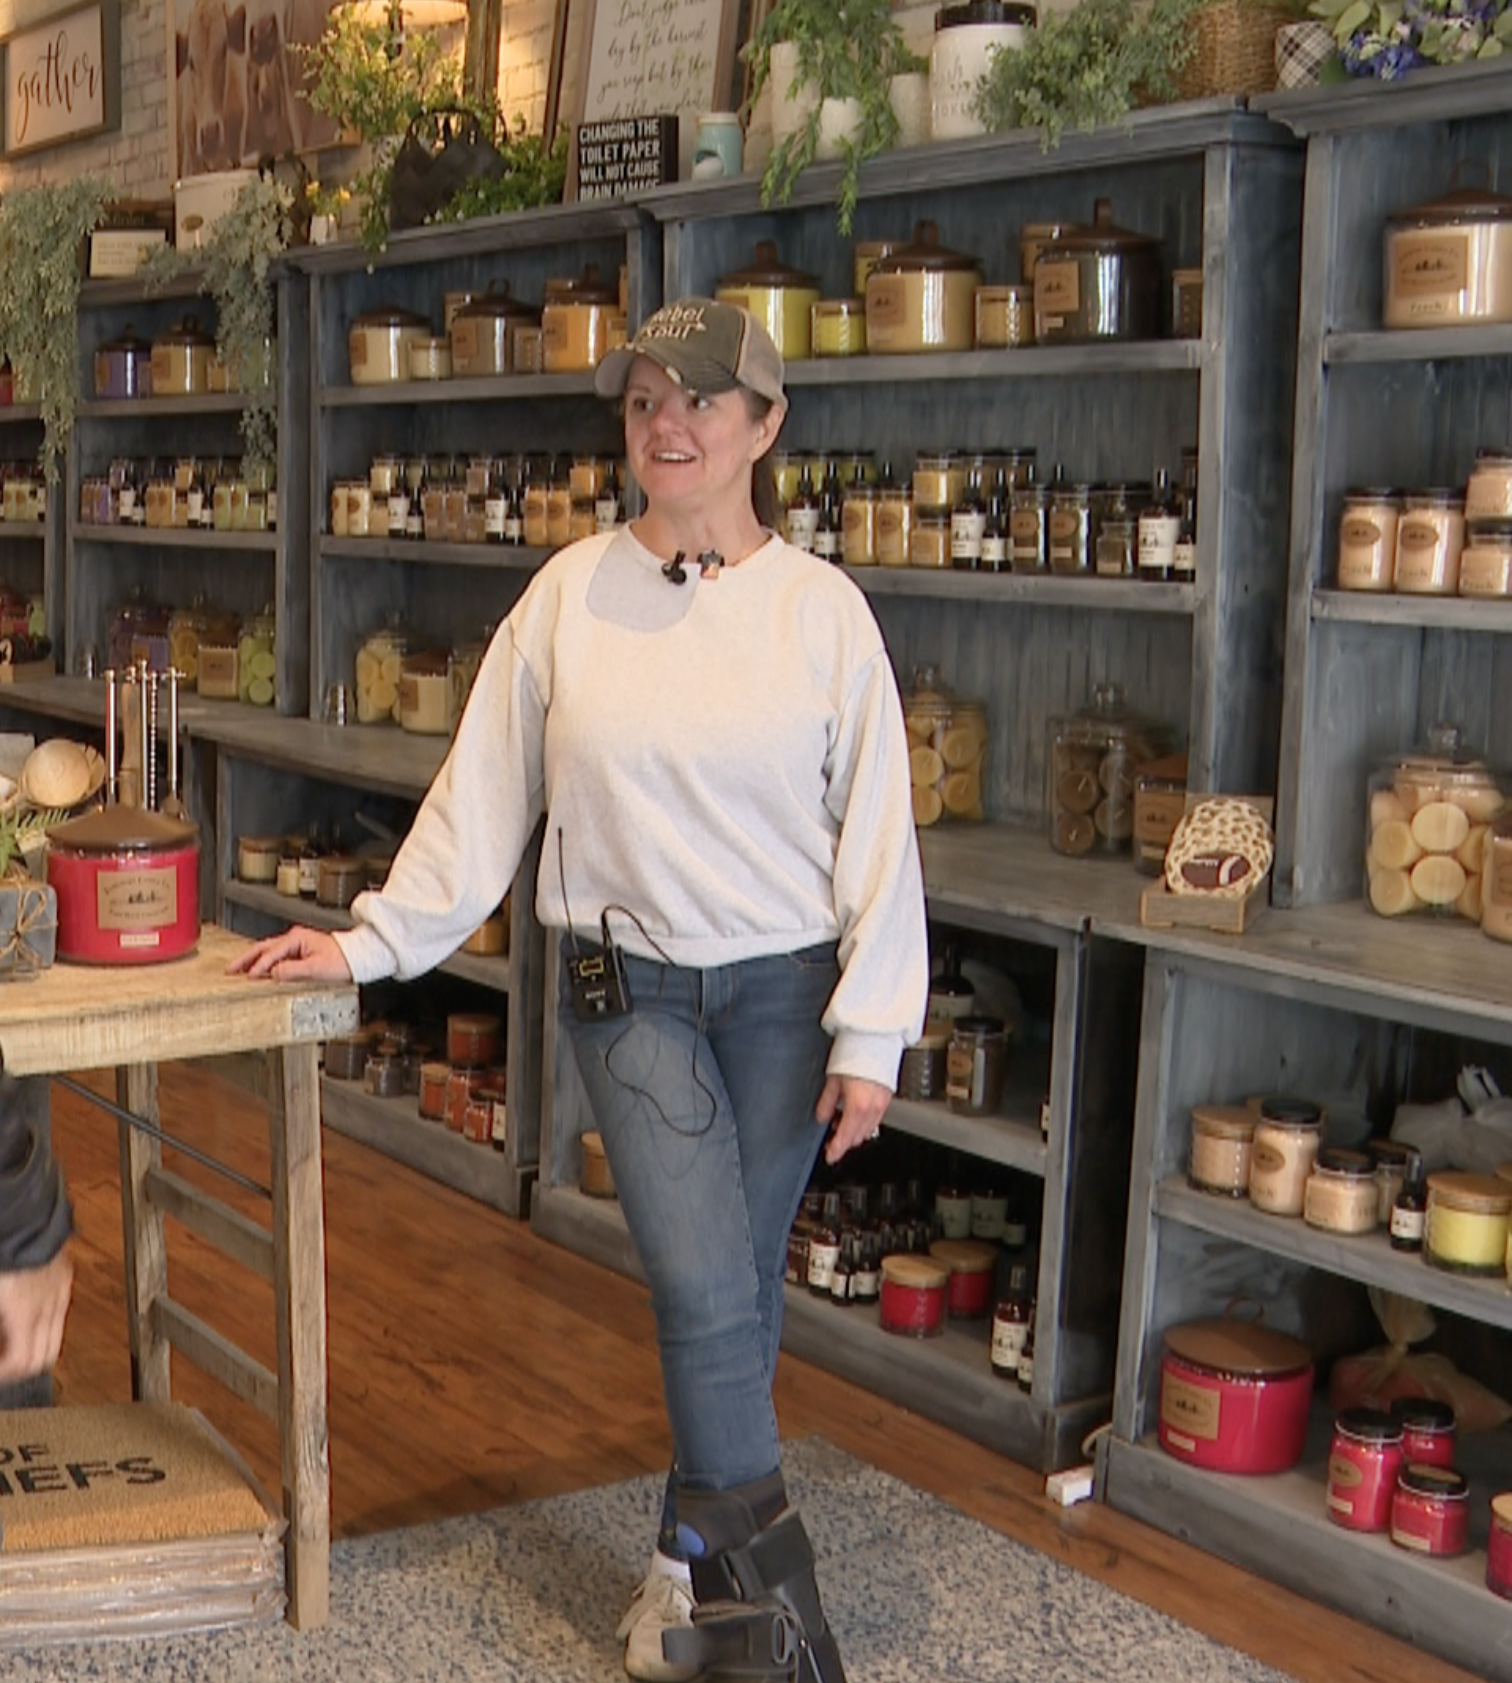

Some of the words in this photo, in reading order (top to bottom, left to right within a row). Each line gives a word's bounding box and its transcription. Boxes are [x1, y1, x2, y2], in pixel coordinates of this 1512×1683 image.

[14, 30, 102, 145] gather
[580, 122, 635, 145] CHANGING
[638, 118, 659, 137] THE
[580, 143, 619, 165] TOILET
[622, 138, 660, 159] PAPER
[580, 165, 604, 184] WILL
[606, 162, 625, 181] NOT
[627, 159, 660, 178] CAUSE
